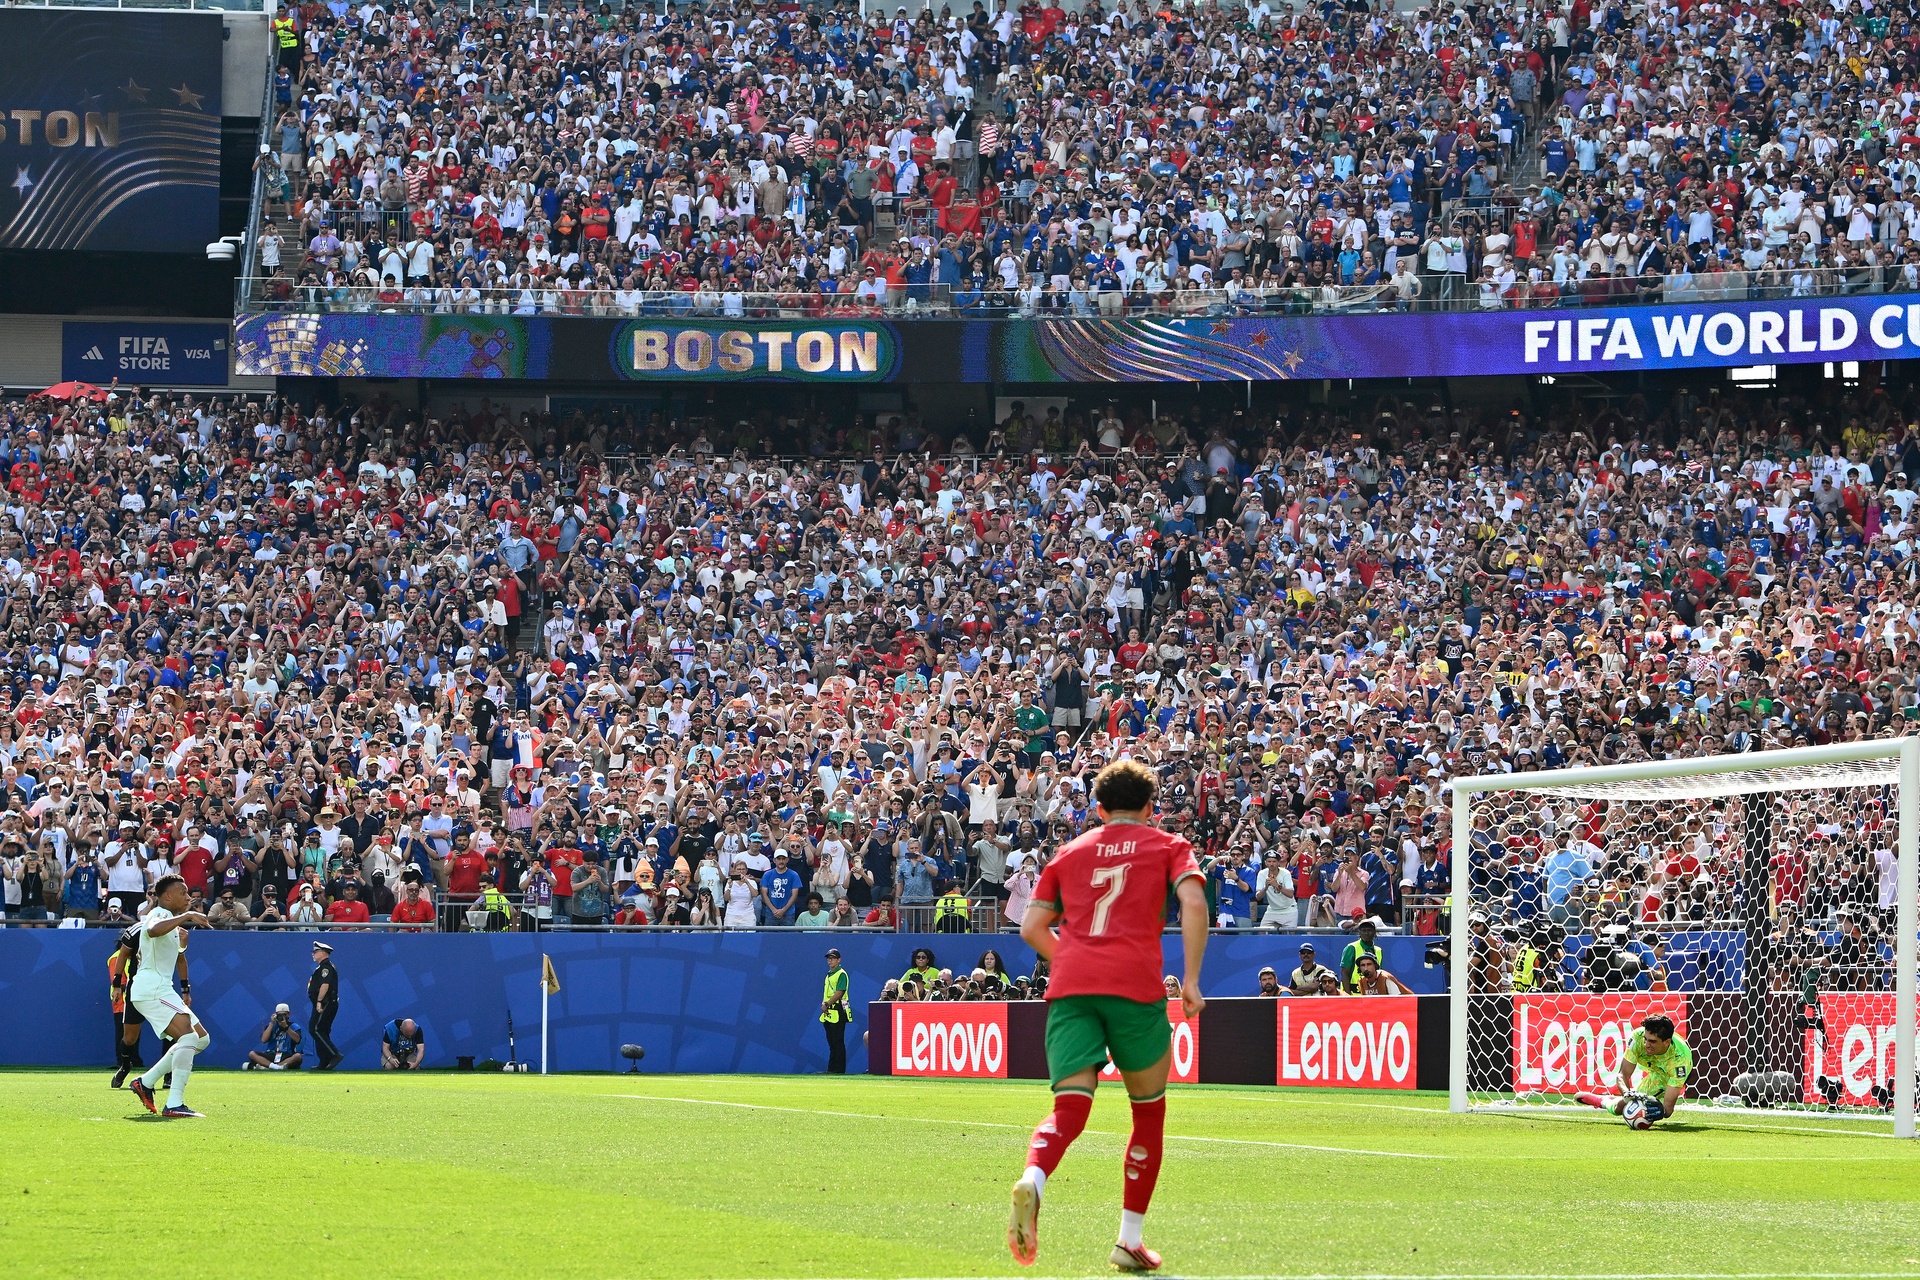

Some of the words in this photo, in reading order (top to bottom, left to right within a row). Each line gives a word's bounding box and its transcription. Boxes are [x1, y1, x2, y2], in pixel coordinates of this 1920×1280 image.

[0, 109, 120, 148] TON
[119, 336, 170, 355] FIFA
[183, 348, 211, 360] VISA
[633, 330, 878, 372] BOSTON
[1524, 316, 1643, 363] FIFA
[1651, 308, 1858, 358] WORLD
[119, 357, 170, 370] STORE
[502, 729, 509, 737] 10
[796, 779, 804, 787] 10
[1096, 841, 1137, 857] TALBI
[1089, 862, 1132, 937] 7
[896, 1009, 1003, 1073] Lenovo
[1282, 1005, 1411, 1082] Lenovo
[1520, 1004, 1642, 1087] Leno
[1813, 1003, 1920, 1097] Len
